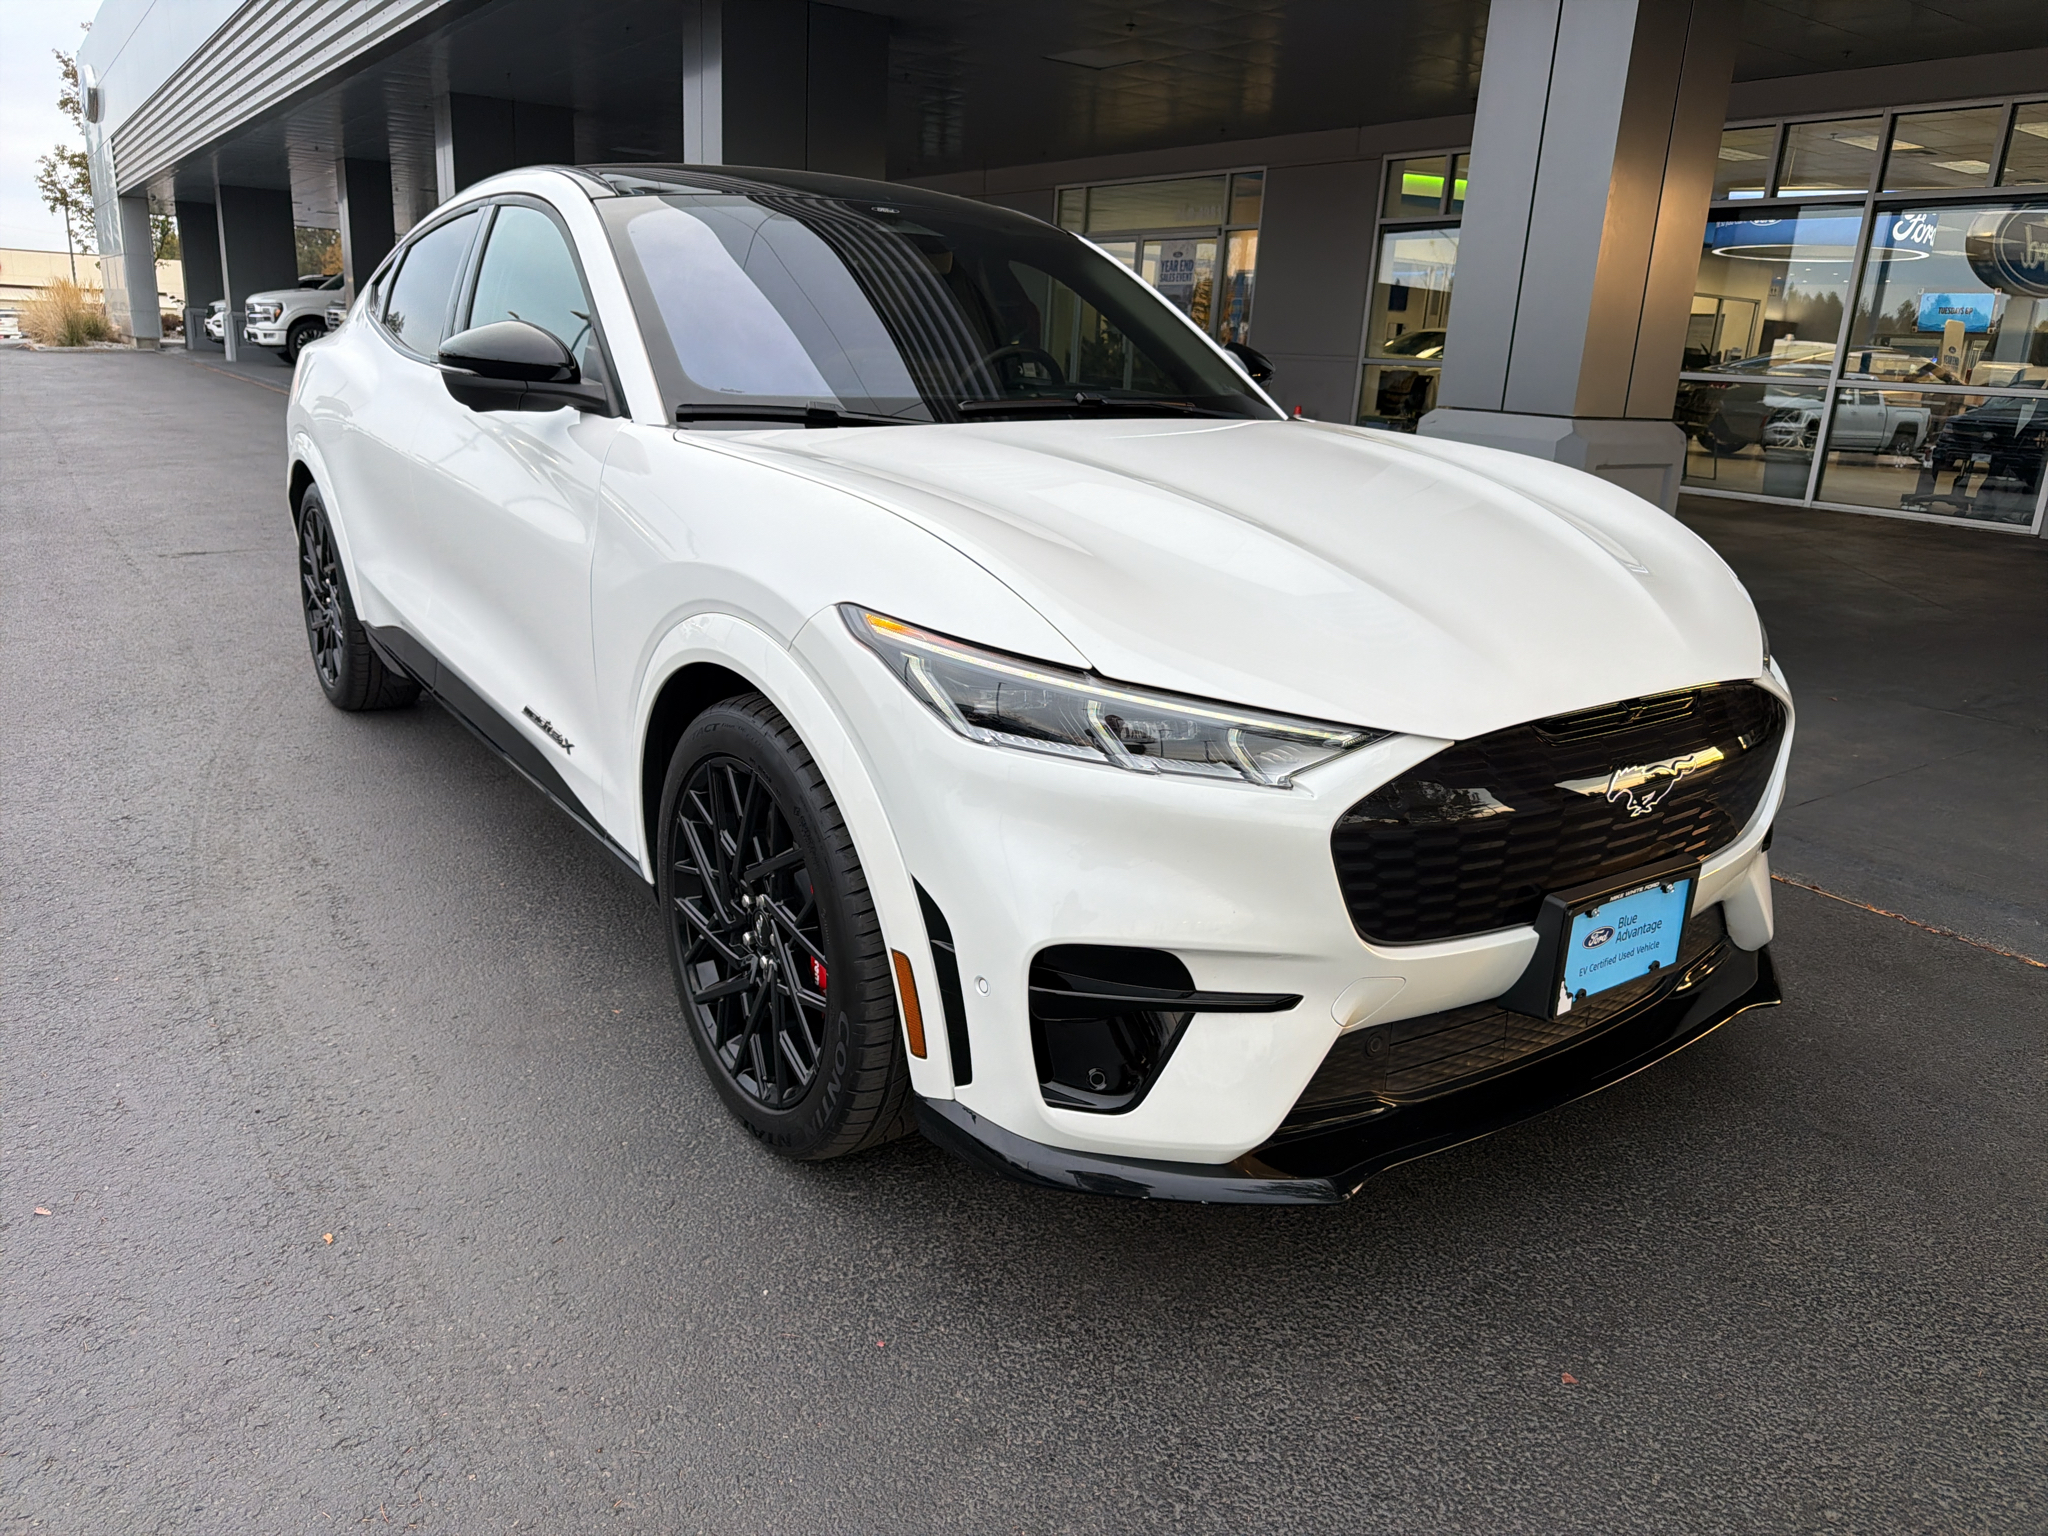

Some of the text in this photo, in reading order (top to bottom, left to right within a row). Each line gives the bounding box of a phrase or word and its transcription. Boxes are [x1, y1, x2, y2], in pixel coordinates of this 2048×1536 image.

[1161, 260, 1194, 272] YEAR END
[1160, 272, 1193, 282] SALES EVENT
[1938, 306, 1965, 315] TUESDAYS
[1625, 886, 1644, 897] WHITE
[1644, 881, 1660, 891] FORD
[1617, 914, 1638, 929] Blue
[1588, 930, 1611, 947] Ford
[1615, 919, 1663, 944] Advantage
[1578, 940, 1660, 977] EV Certified Used Vehicle
